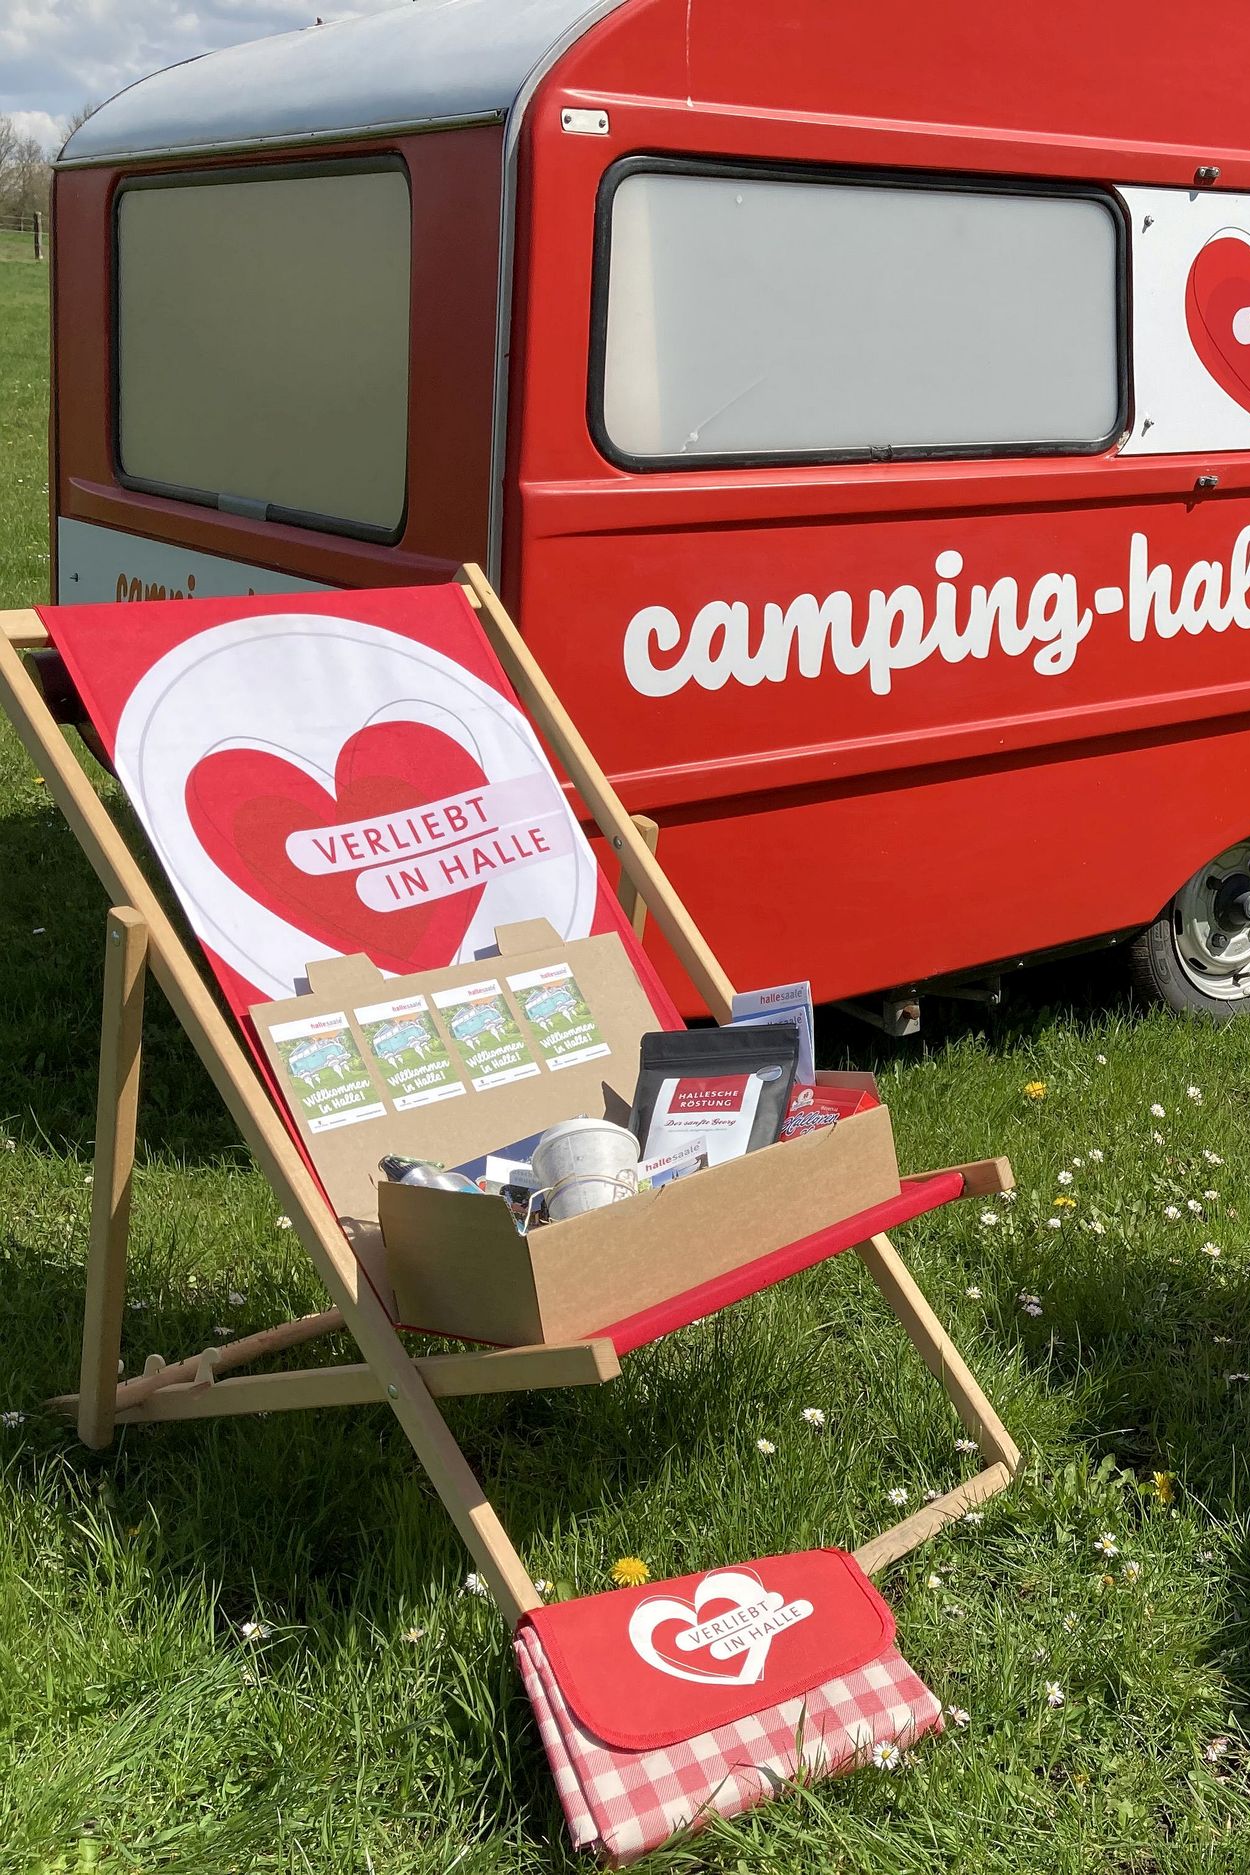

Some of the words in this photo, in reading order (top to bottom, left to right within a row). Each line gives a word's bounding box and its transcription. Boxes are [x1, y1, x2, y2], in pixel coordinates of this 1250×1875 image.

[311, 796, 488, 864] VERLIEBT
[385, 867, 430, 900] IN
[438, 828, 551, 885] HALLE
[760, 986, 804, 1004] hallesaale
[539, 1023, 596, 1049] Willkommen
[465, 1041, 525, 1068] Willkommen
[553, 1045, 565, 1055] in
[386, 1060, 450, 1087] Willkommen
[402, 1083, 415, 1093] in
[413, 1070, 447, 1089] Halle!
[480, 1064, 492, 1074] in
[302, 1079, 371, 1108] Willkommen
[319, 1104, 332, 1115] in
[330, 1091, 366, 1110] Halle!
[678, 1090, 739, 1100] HALLESCHE
[680, 1099, 732, 1108] RÖSTUNG
[664, 1119, 682, 1127] Der
[684, 1119, 710, 1127] sanfte
[645, 1140, 701, 1172] hallesaale
[688, 1600, 769, 1645] VERLIEBT
[723, 1636, 745, 1652] IN
[749, 1605, 802, 1641] HALLE
